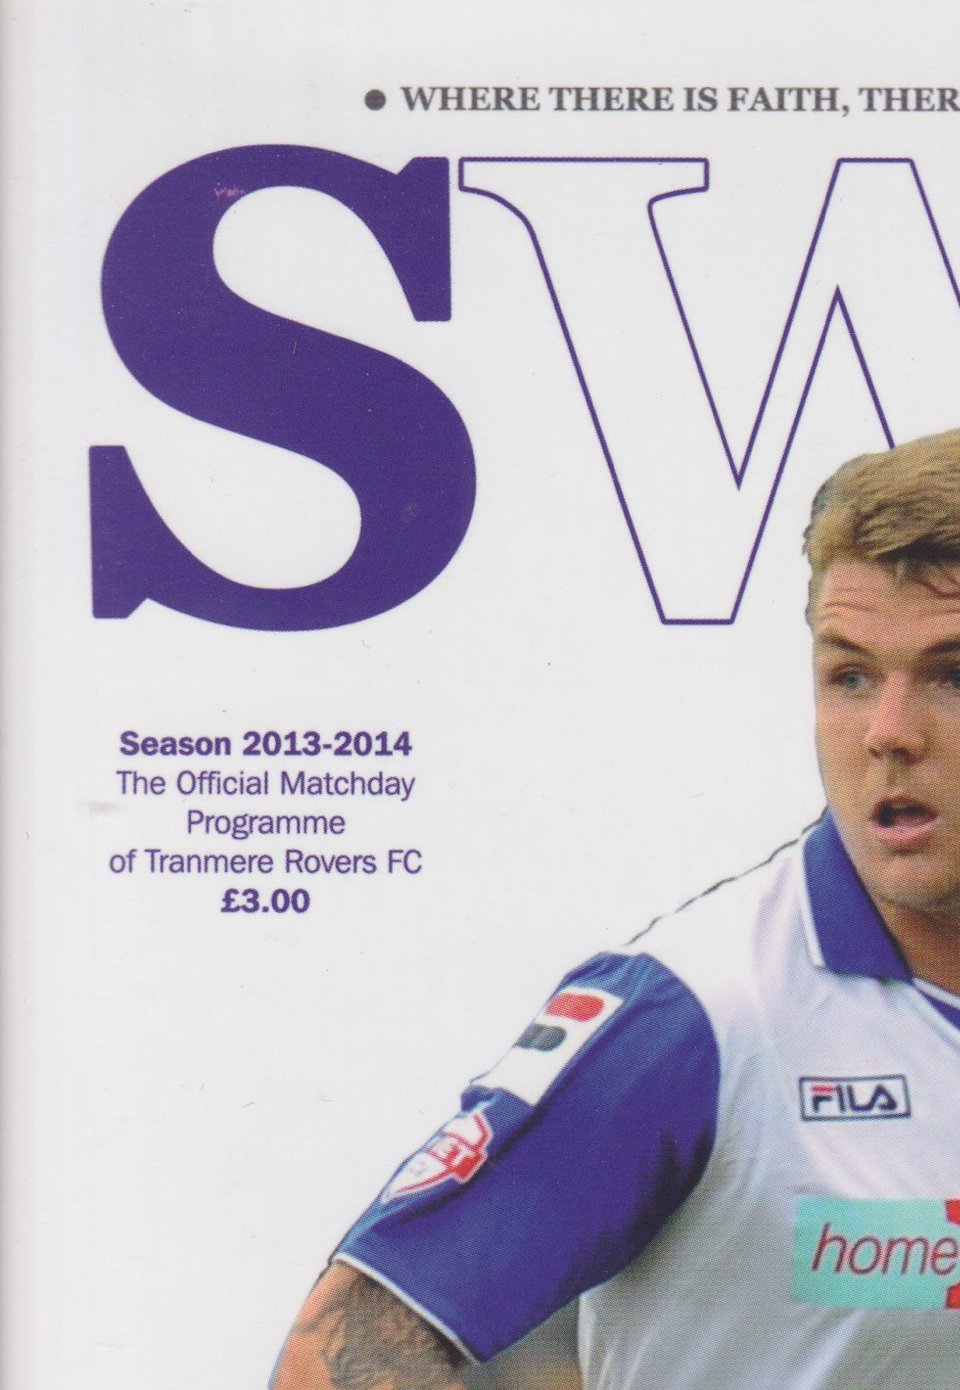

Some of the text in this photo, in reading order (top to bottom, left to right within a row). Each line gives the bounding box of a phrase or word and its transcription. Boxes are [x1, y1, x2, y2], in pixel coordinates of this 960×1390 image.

[400, 87, 540, 112] WHERE
[549, 87, 674, 112] THERE
[684, 87, 718, 112] IS
[728, 87, 849, 117] FAITH,
[120, 730, 413, 756] Season 2013-2014
[116, 770, 415, 801] The Official Matchday
[188, 809, 346, 840] Programme
[110, 849, 422, 874] of Tranmere Rovers FC
[221, 888, 310, 913] £3.00
[809, 1084, 898, 1114] FILA
[811, 1221, 960, 1276] home
